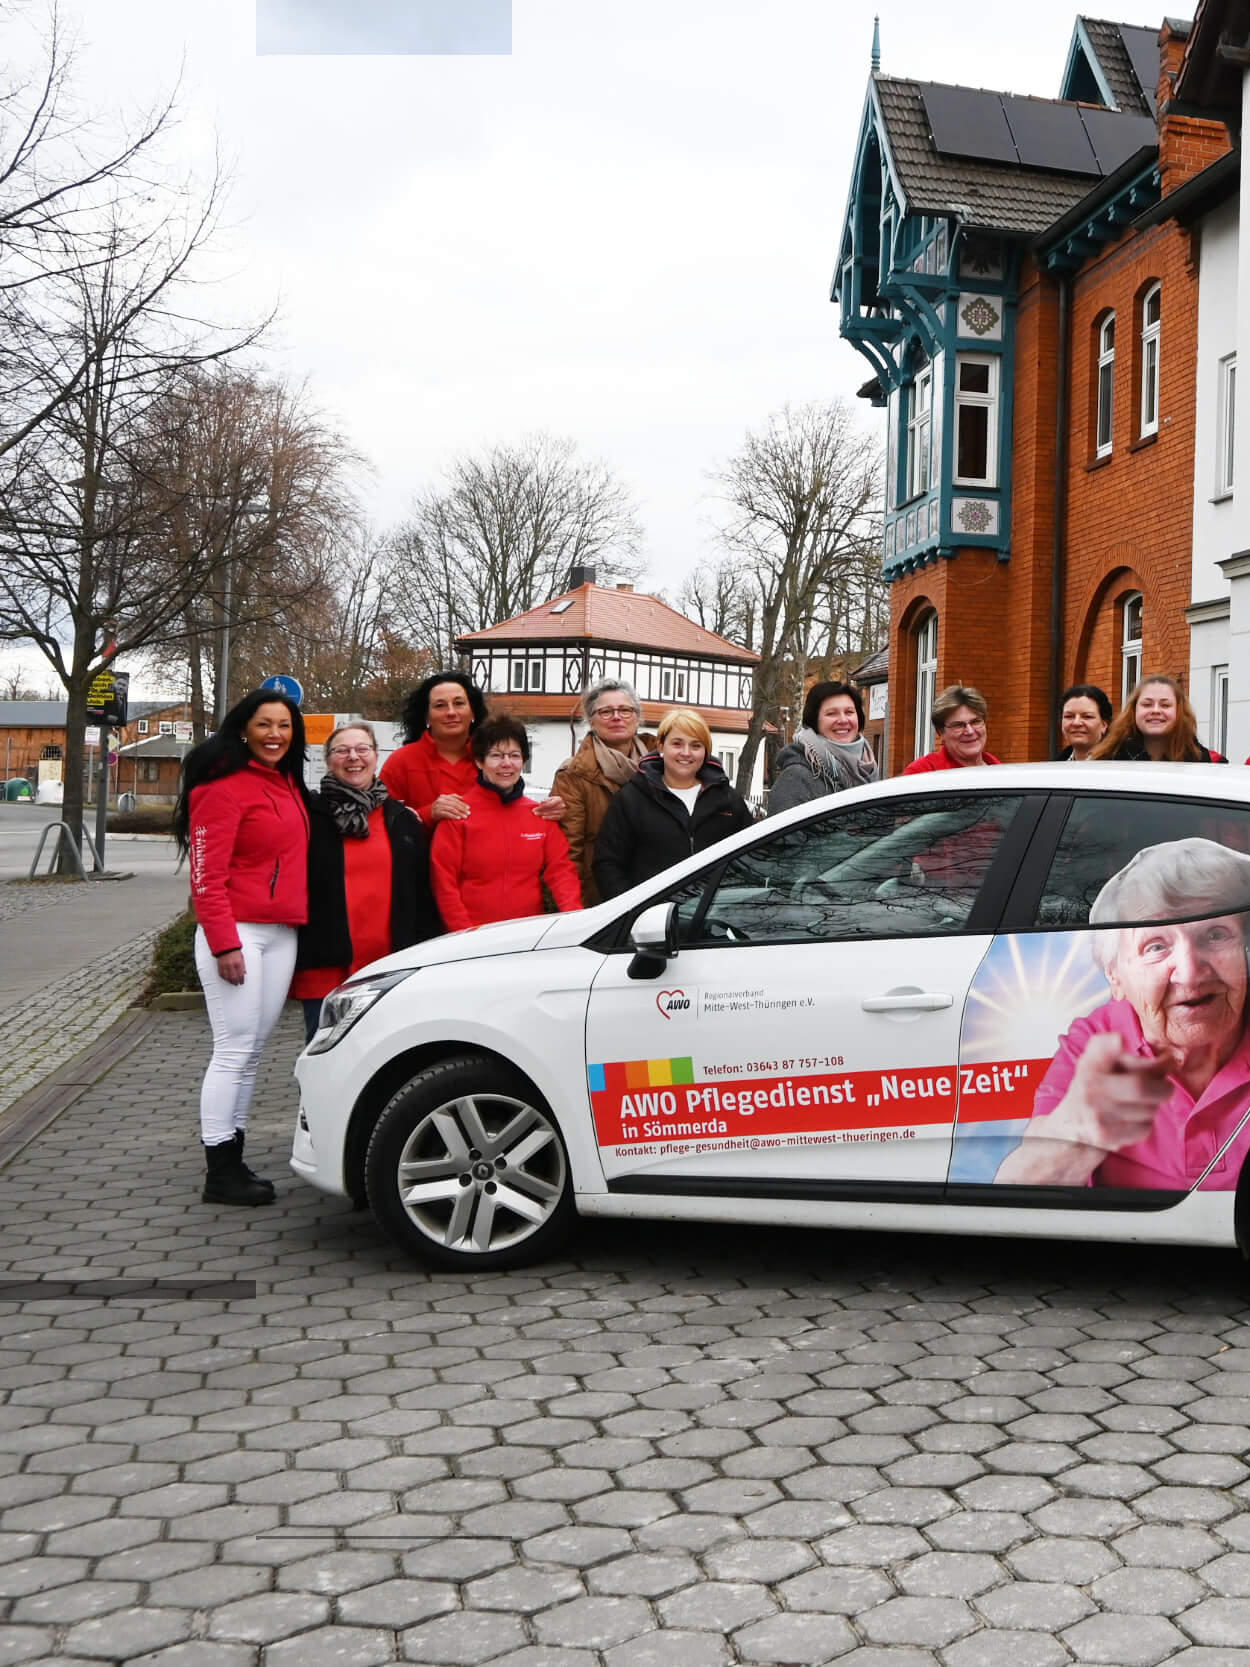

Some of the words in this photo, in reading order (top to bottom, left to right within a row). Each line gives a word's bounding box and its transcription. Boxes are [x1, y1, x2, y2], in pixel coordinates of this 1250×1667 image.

[666, 999, 691, 1010] AWO
[704, 989, 764, 1001] Regionalverband
[799, 997, 815, 1007] e.V.
[703, 1065, 743, 1075] Telefon:
[746, 1060, 778, 1072] 03643
[782, 1060, 794, 1069] 87
[799, 1056, 844, 1068] 757-108
[620, 1091, 678, 1118] AWO
[686, 1081, 856, 1115] Pflegedienst
[622, 1123, 638, 1139] in
[643, 1118, 727, 1137] Sömmerda
[615, 1147, 657, 1157] Kontakt:
[660, 1128, 916, 1155] pflege-gesundheit@awo-mittewest-thueringen.de
